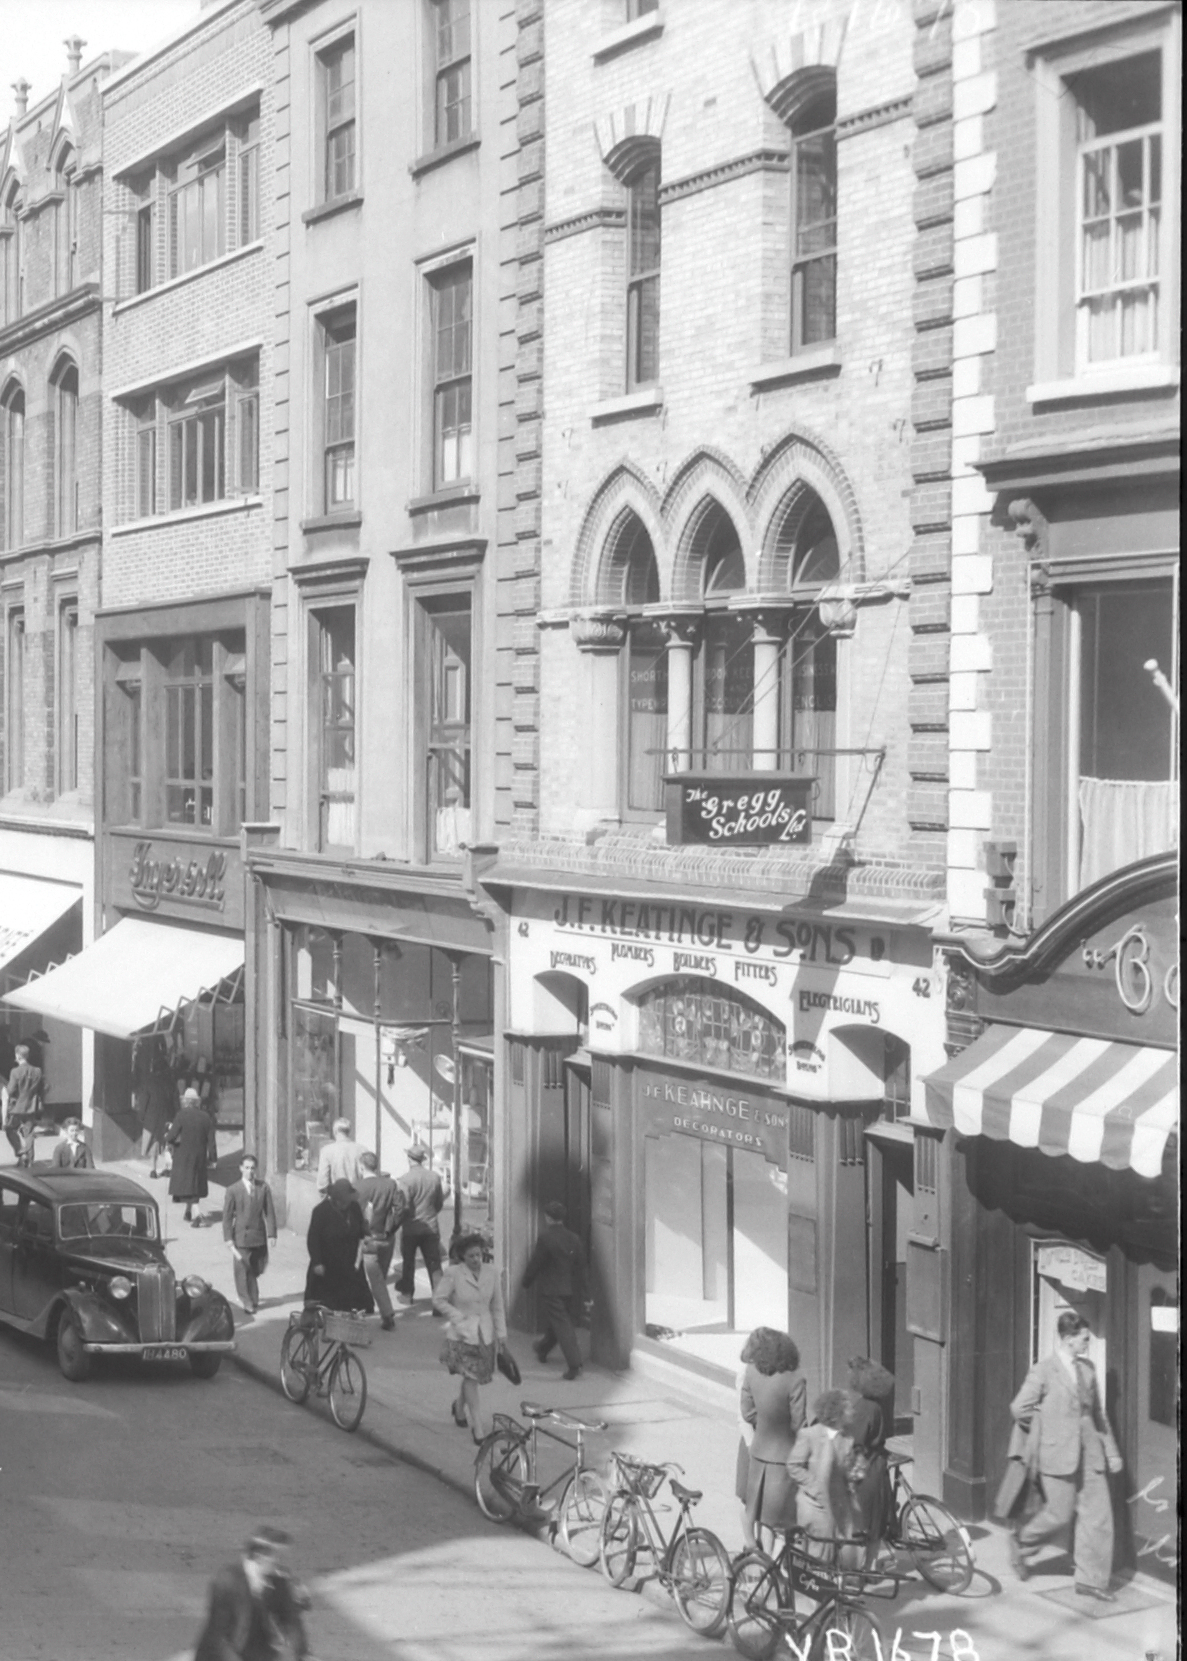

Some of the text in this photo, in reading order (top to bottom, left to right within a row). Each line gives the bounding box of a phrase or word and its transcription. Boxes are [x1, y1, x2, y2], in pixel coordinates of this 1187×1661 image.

[685, 788, 709, 802] The
[709, 802, 791, 839] Schools
[517, 921, 530, 938] 42
[601, 898, 732, 950] KEATINGE
[744, 916, 765, 954] &
[773, 919, 857, 966] SONS
[611, 943, 655, 968] PLUMBERS
[673, 952, 717, 977] BUILDERS
[734, 960, 778, 988] FITTERS
[912, 977, 932, 999] 42
[799, 990, 881, 1024] ELECTRICIANS
[664, 1083, 750, 1121] KEATINGE
[673, 1116, 763, 1147] DECORATORS
